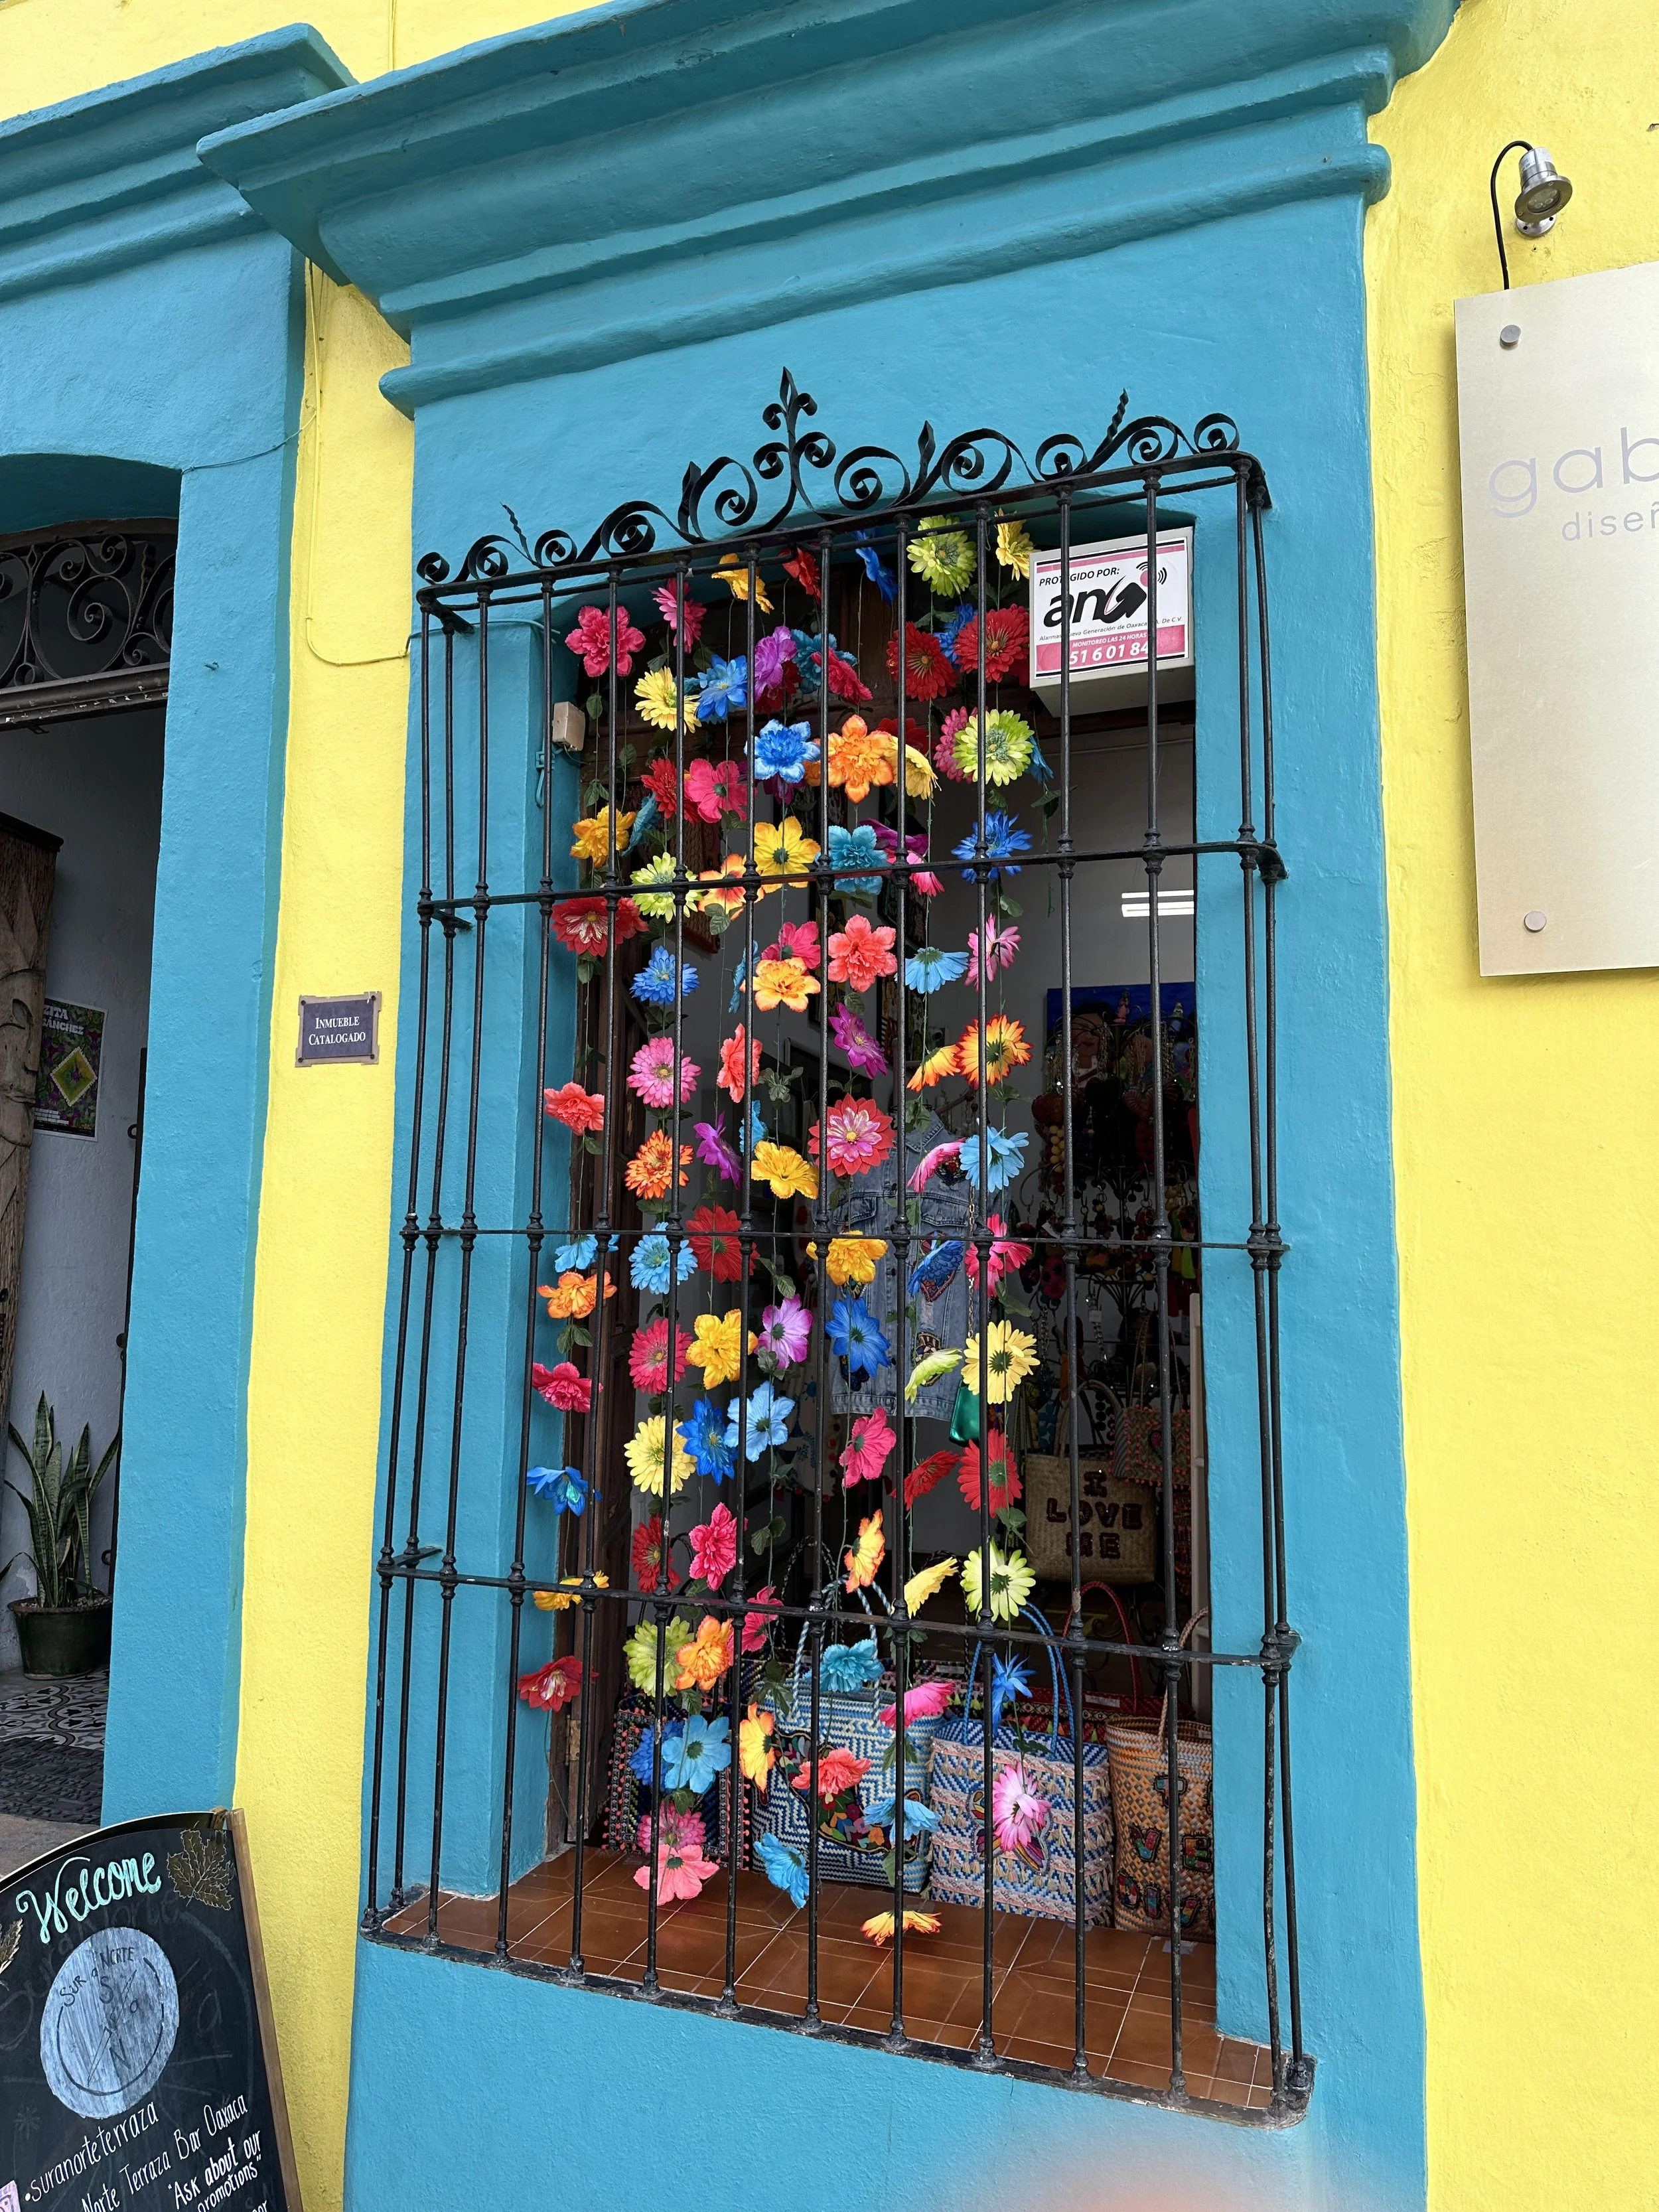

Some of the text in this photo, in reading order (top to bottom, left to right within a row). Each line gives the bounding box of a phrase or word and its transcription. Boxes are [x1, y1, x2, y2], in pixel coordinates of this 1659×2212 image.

[1039, 567, 1120, 587] PROTGIDO POR:
[1083, 627, 1116, 635] Generación
[1072, 638, 1107, 648] MONITOREO
[1092, 647, 1102, 661] 6
[1106, 644, 1125, 658] 01
[43, 1004, 69, 1020] ZITA
[315, 1016, 360, 1029] INMUEBLE
[309, 1031, 366, 1046] CATALOGADO
[1083, 1471, 1108, 1498] I
[1046, 1497, 1143, 1530] LOVE
[1066, 1531, 1121, 1560] ME
[15, 1852, 162, 1944] Welcome
[119, 2151, 171, 2195] Terraza
[173, 2128, 201, 2160] Bar
[203, 2095, 248, 2136] Oaxaca
[204, 2136, 239, 2187] about
[243, 2130, 261, 2160] our
